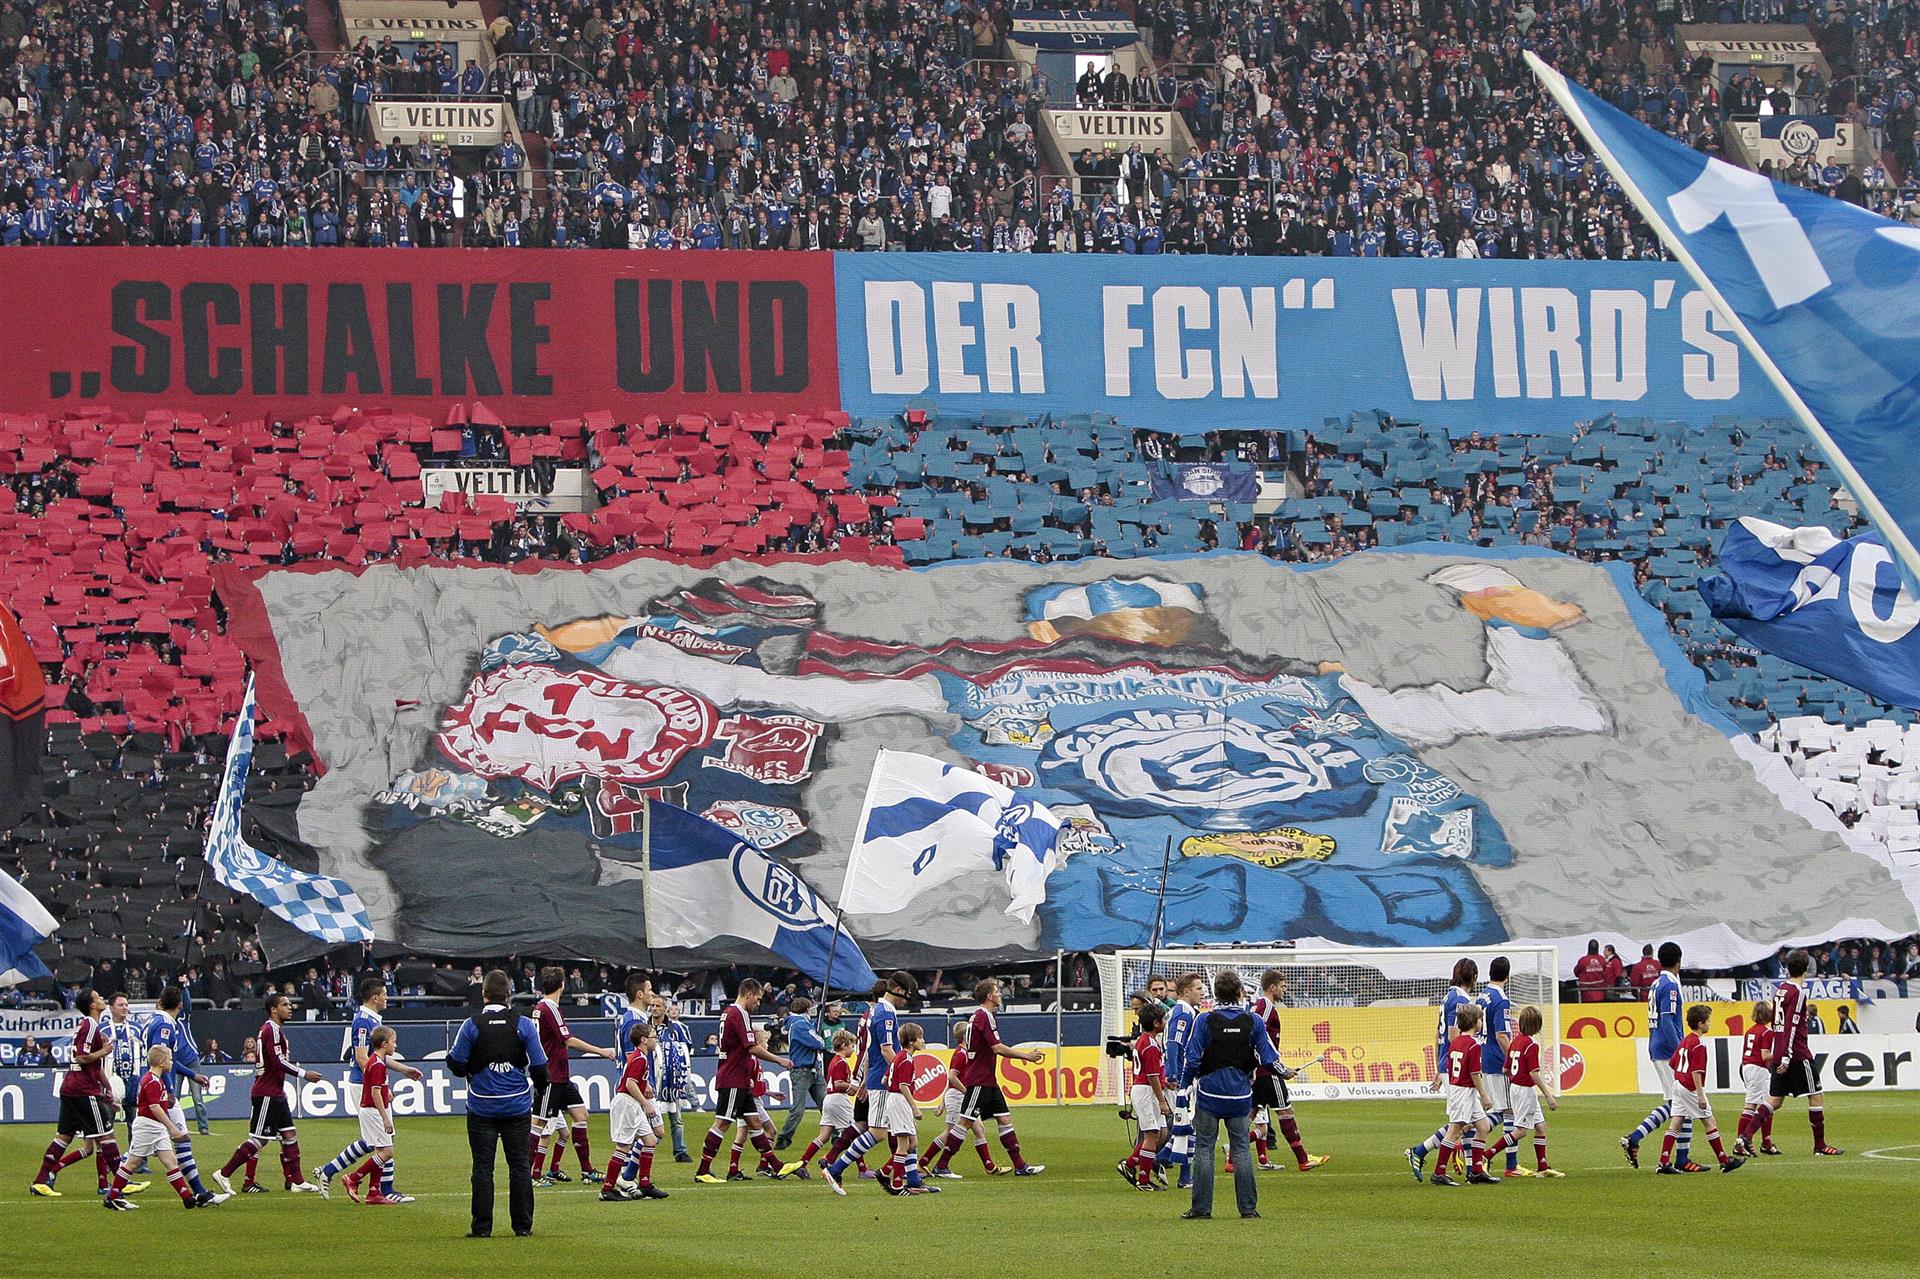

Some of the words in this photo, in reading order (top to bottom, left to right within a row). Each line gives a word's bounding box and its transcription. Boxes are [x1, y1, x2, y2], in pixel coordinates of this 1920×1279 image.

[379, 18, 479, 29] VELTINS
[1022, 22, 1137, 32] SCHALKE
[1721, 41, 1810, 52] VELTINS
[1773, 53, 1785, 62] 35
[406, 107, 495, 128] VELTINS
[1079, 115, 1165, 136] VELTINS
[459, 134, 473, 144] 32
[613, 278, 809, 394] UND
[864, 280, 1046, 395] DER
[1347, 1086, 1417, 1097] Volkswagen.
